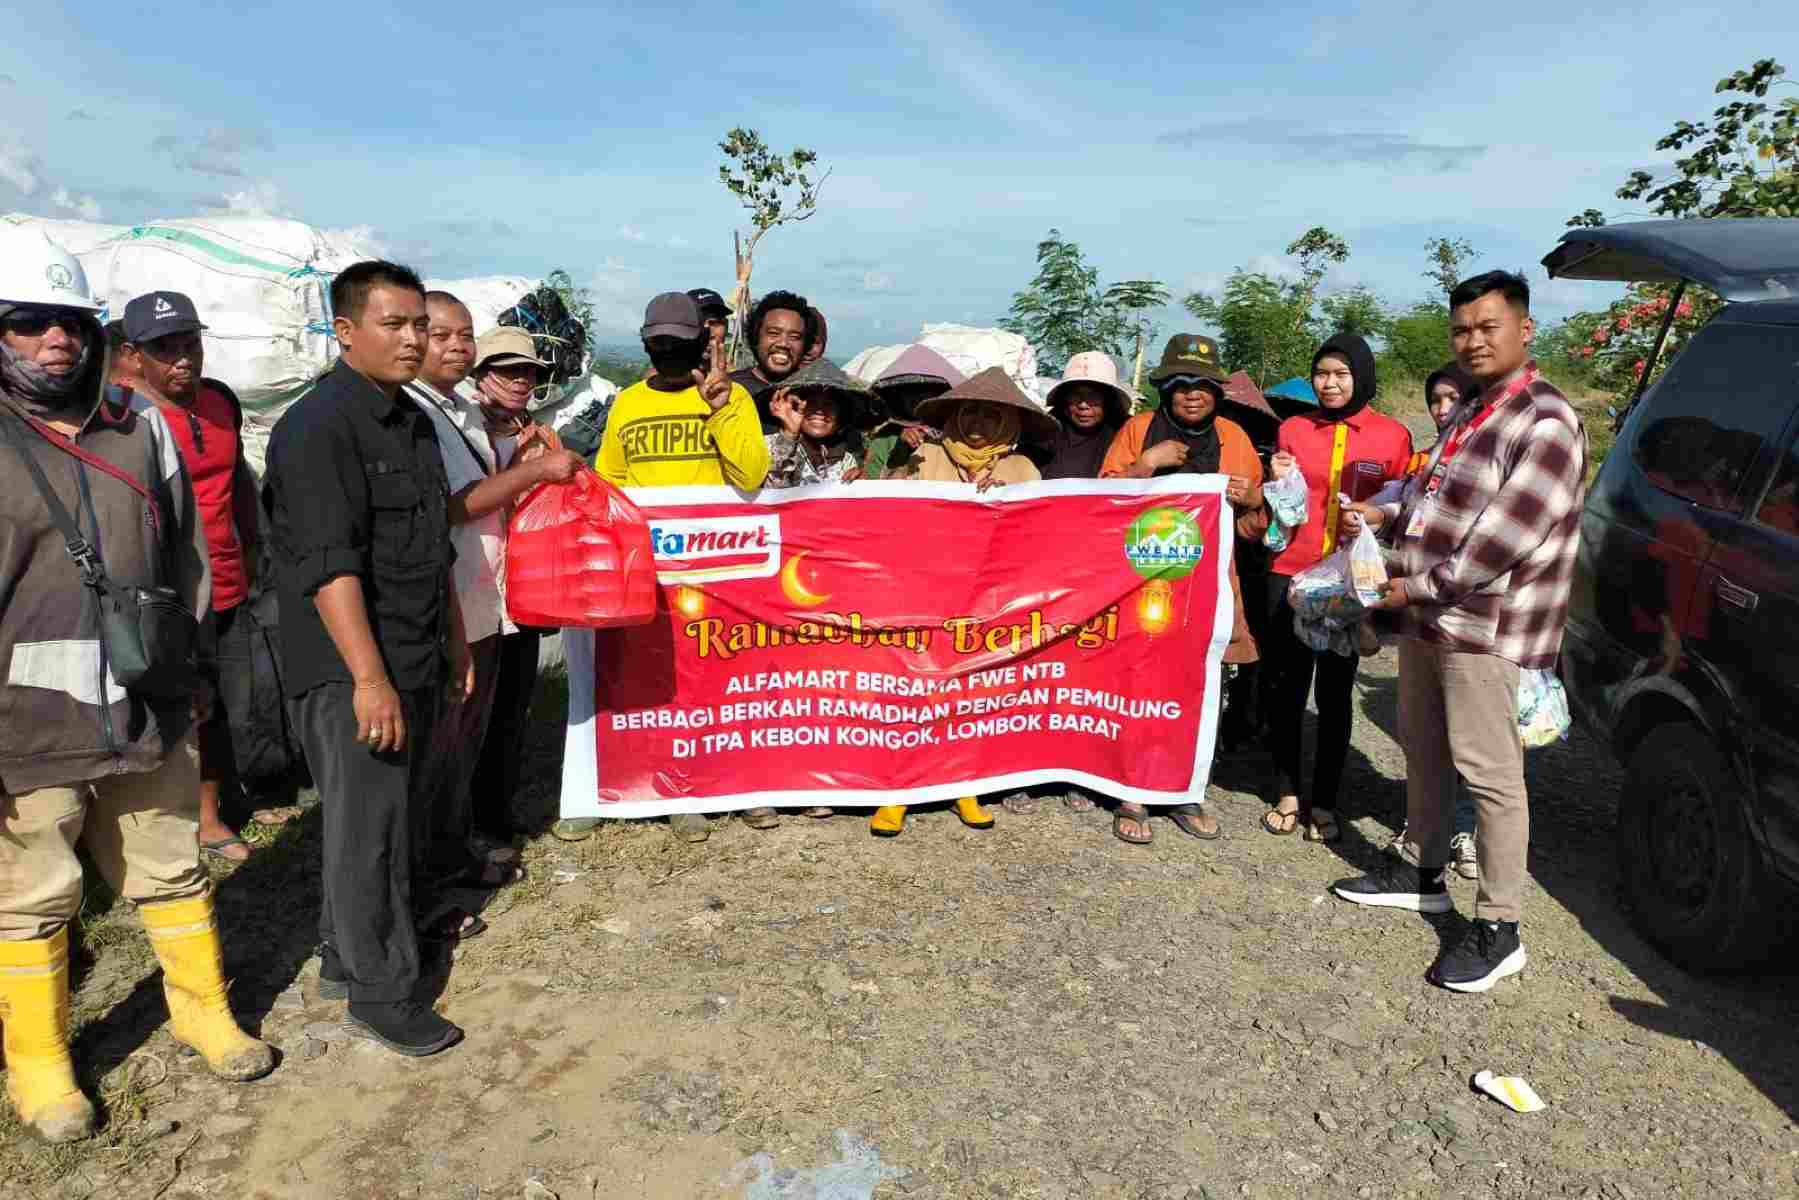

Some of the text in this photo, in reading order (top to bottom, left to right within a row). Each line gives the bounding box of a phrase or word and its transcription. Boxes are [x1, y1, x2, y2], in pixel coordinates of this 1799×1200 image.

[650, 524, 772, 555] famart
[685, 610, 933, 660] Ramadhan
[725, 661, 1066, 698] ALFAMART BERSAMA FWE NTB
[611, 687, 1183, 731] BERBAGI BERKAH RAMADHAN DENGAN PEMULUNG
[671, 713, 1122, 759] DI TPA KEBON KONGOK, LOMBOK BARAT
